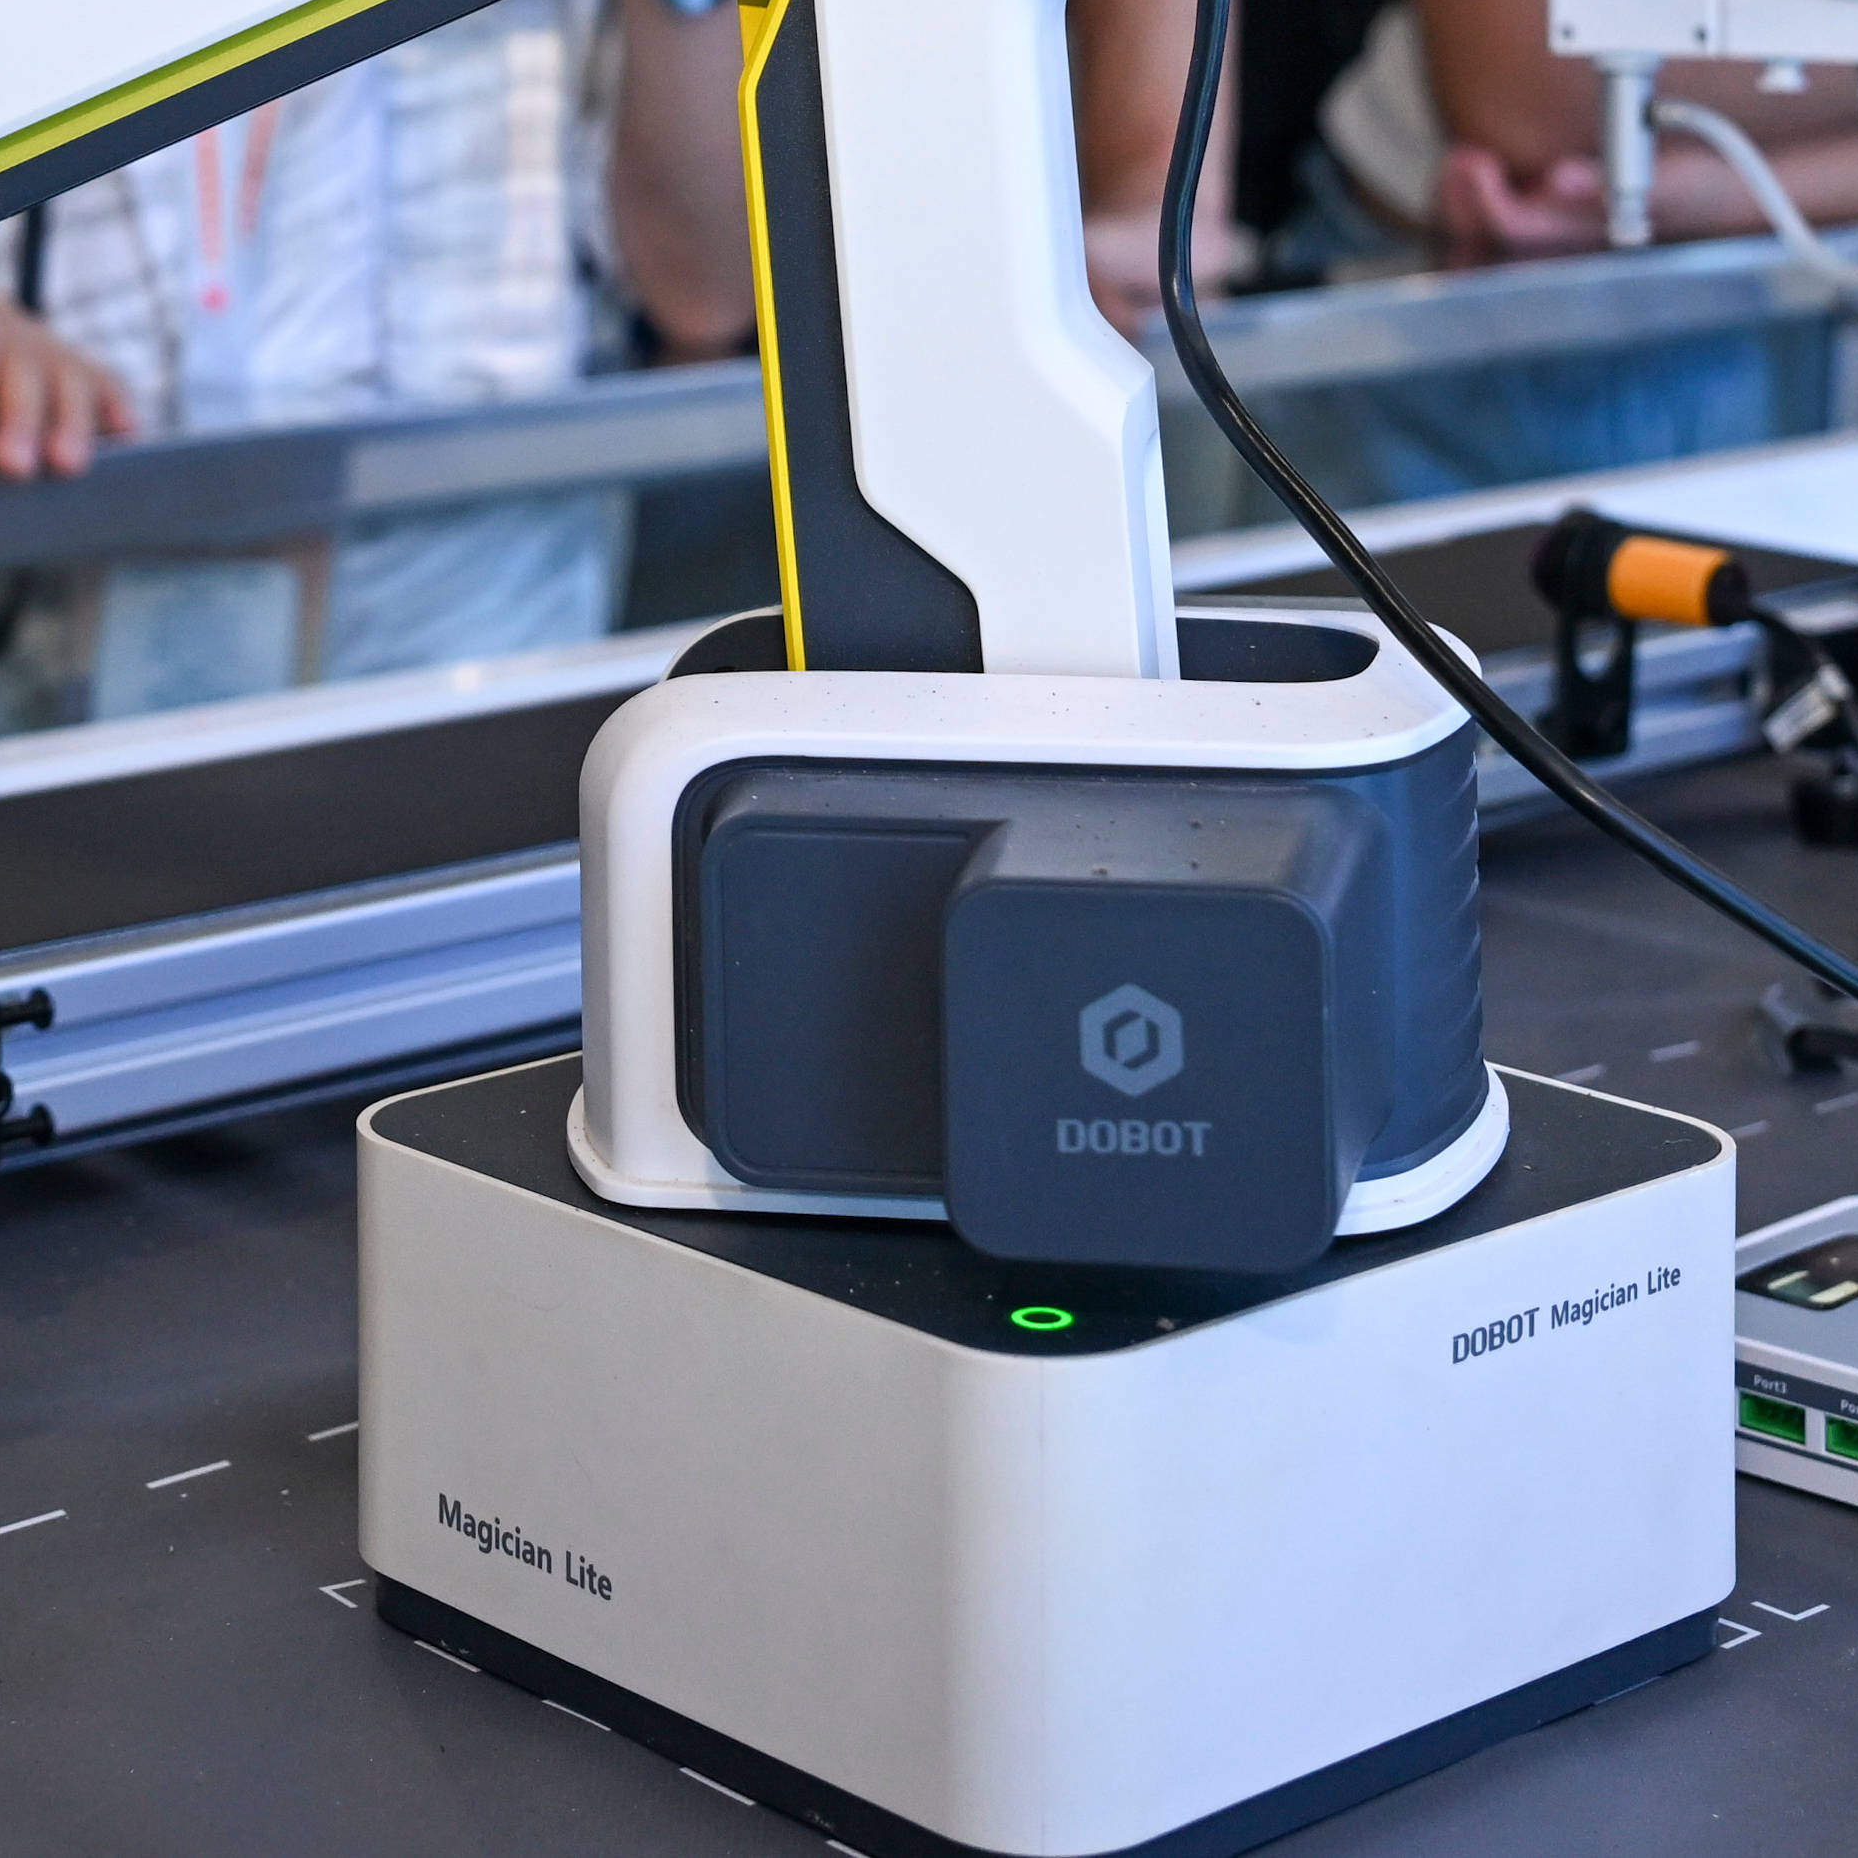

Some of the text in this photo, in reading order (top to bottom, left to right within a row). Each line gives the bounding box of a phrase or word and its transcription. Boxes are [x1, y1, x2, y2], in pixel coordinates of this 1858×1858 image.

[1056, 1118, 1213, 1157] DOBOT
[1452, 1266, 1681, 1364] DOBOT Magician Lite
[1753, 1373, 1788, 1394] Port3
[439, 1493, 612, 1601] Magician Lite
